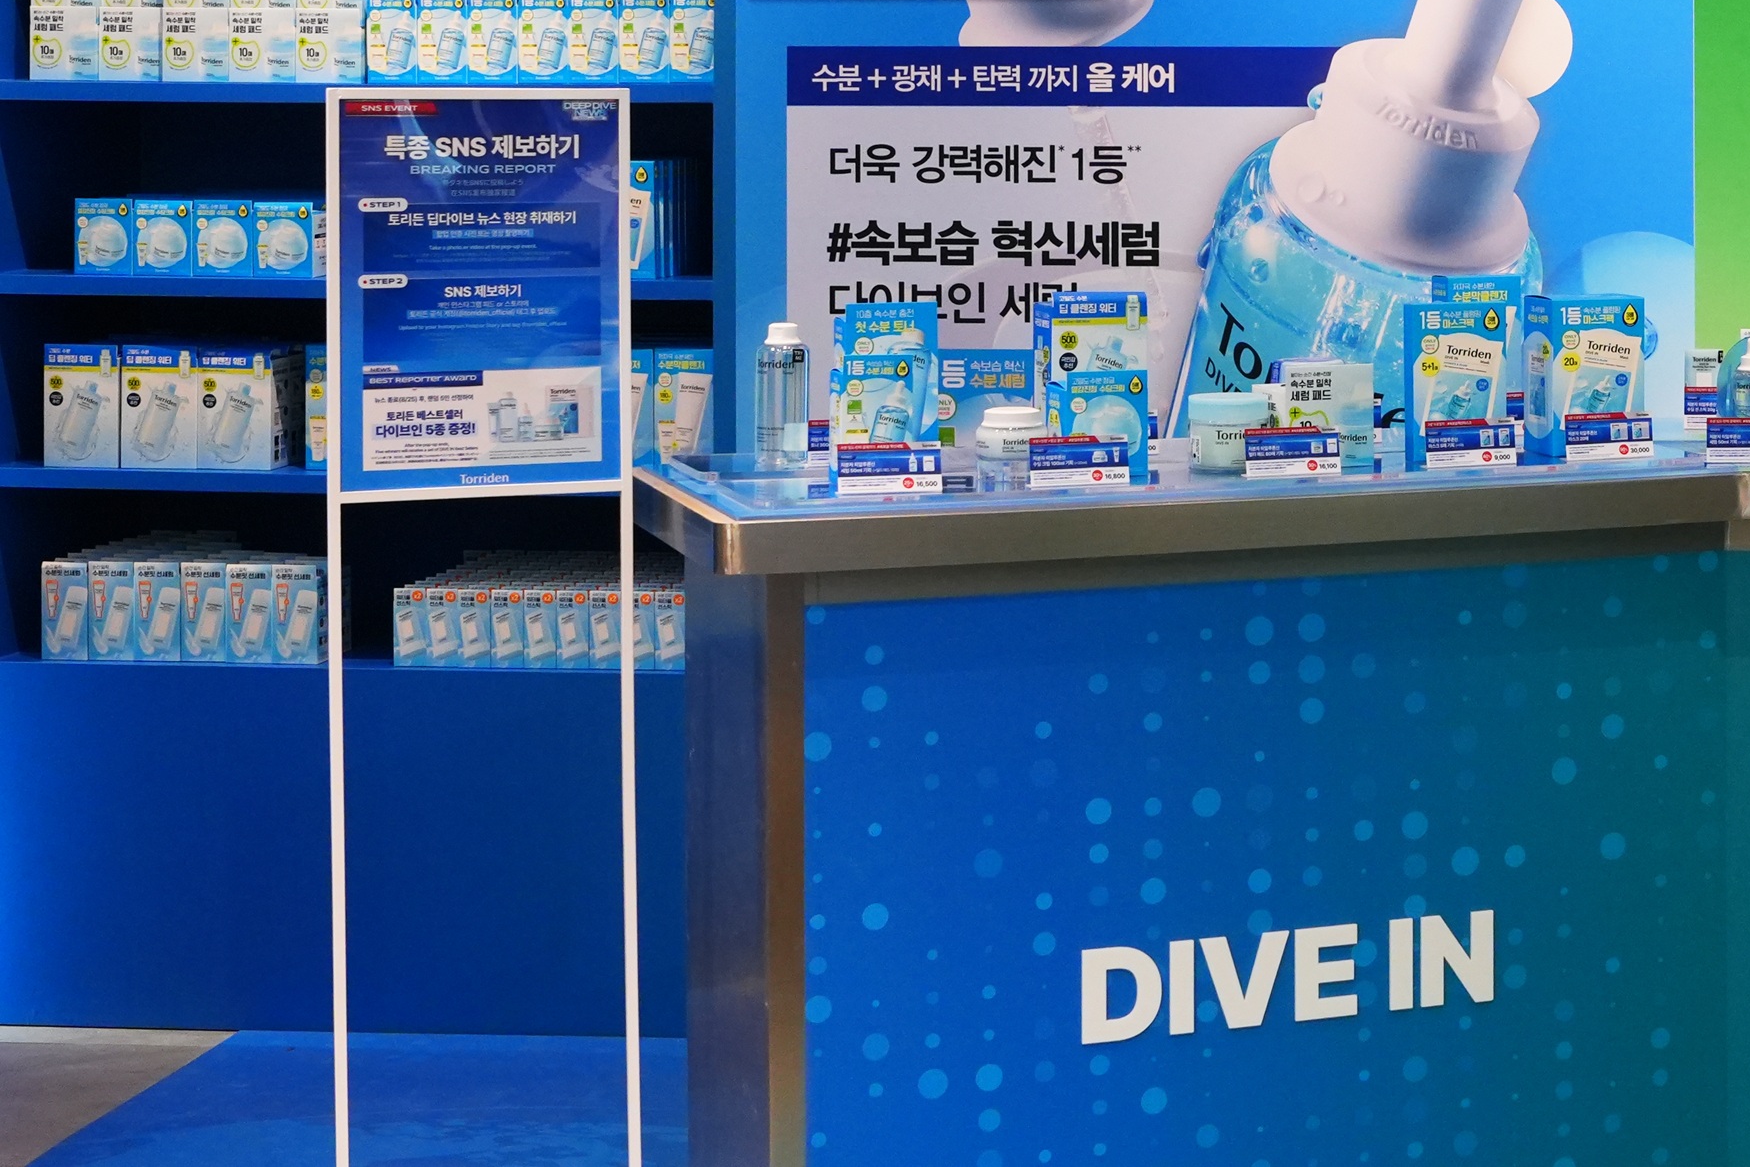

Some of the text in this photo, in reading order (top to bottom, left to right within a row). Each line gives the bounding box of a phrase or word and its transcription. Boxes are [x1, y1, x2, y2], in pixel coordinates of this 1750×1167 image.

[810, 60, 1177, 93] 수분 + 광채 + 탄력 까지 올 케어
[360, 104, 418, 112] SNS EVENT
[383, 133, 579, 160] 특종 SNS 제보하기
[409, 163, 556, 174] BREAKING REPORT
[828, 143, 899, 185] 더욱
[368, 200, 395, 208] STEP
[387, 210, 576, 226] 토리든 딥다이브 뉴스 현장 취재하기
[826, 219, 1161, 268] #속보습 혁신세럼
[368, 277, 395, 285] STEP
[443, 283, 522, 298] SNS 제보하기
[1445, 344, 1492, 360] Torriden
[1586, 339, 1630, 355] Torriden
[1290, 378, 1314, 389] 속수분
[1290, 389, 1331, 401] 세럼 패드
[385, 408, 463, 421] 토리든 베스트셀러
[375, 421, 476, 438] 다이브인 5종 증정!
[1630, 446, 1649, 454] 30,000
[459, 472, 509, 484] Torriden
[1078, 907, 1497, 1044] DIVE IN
